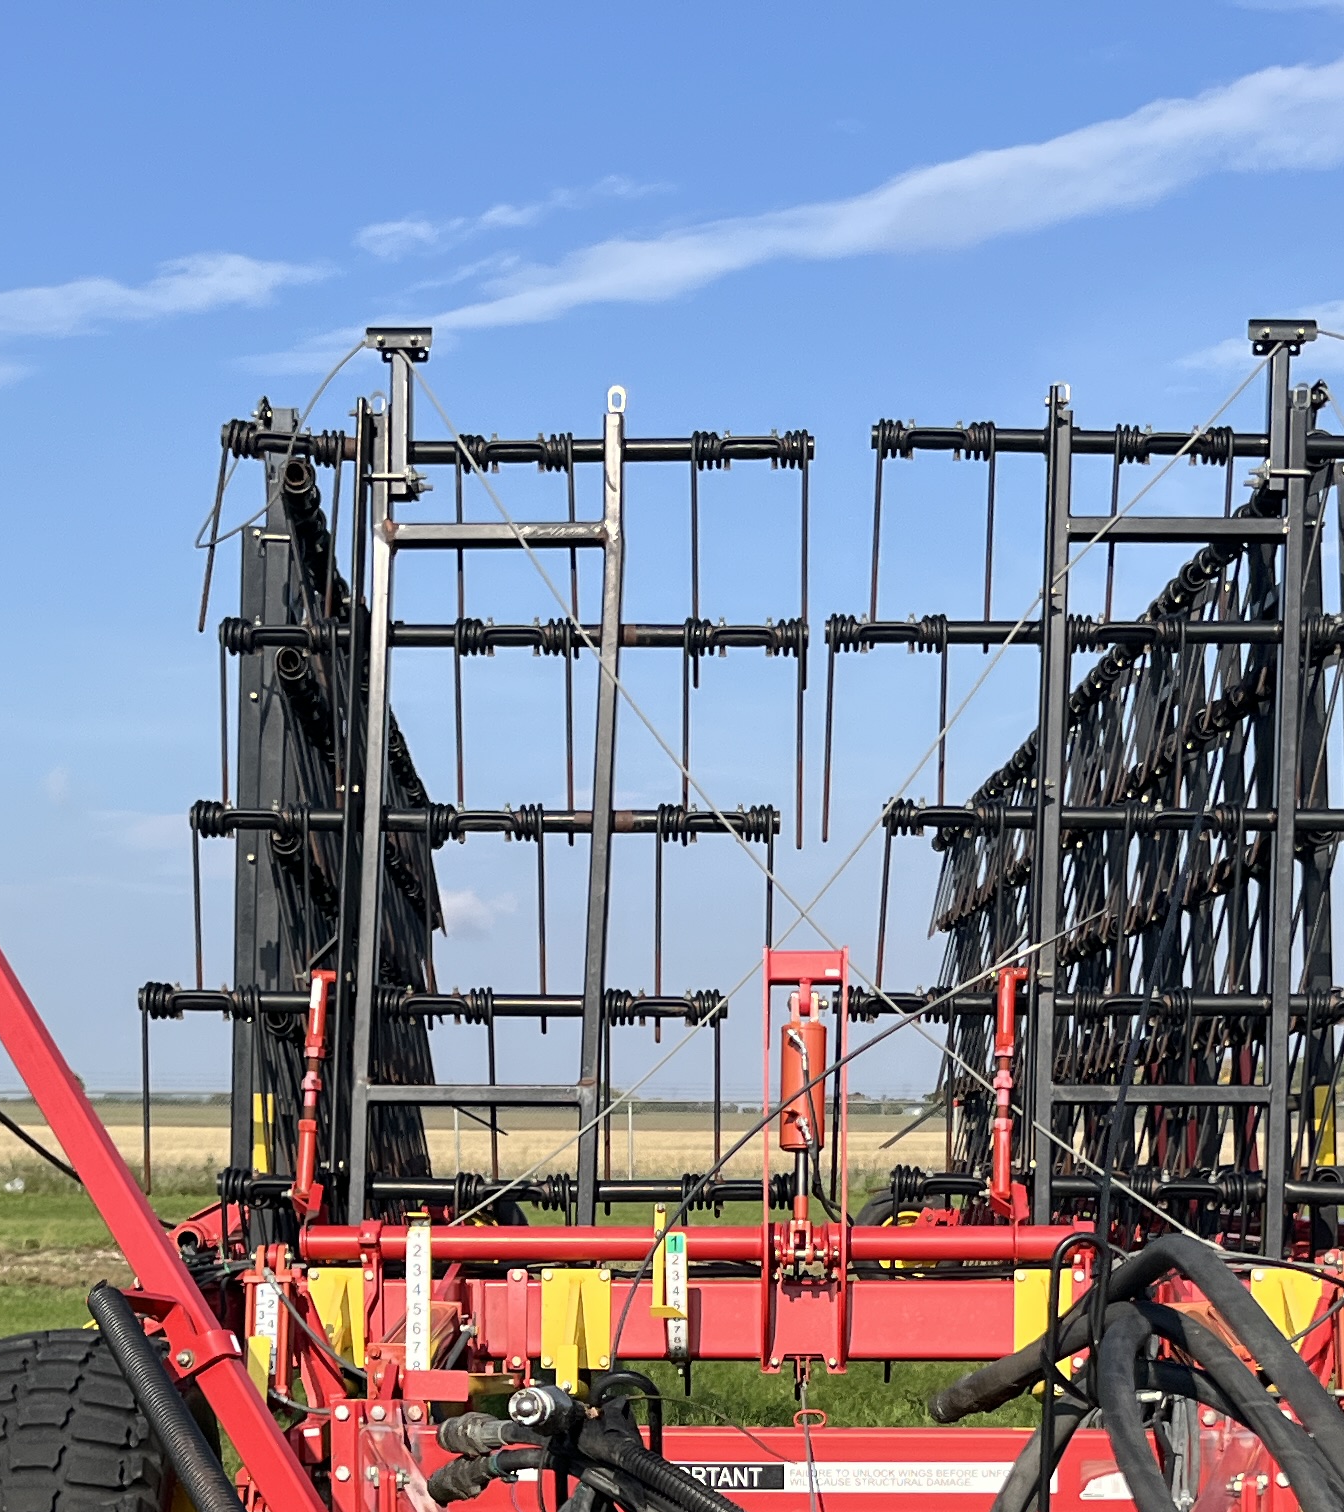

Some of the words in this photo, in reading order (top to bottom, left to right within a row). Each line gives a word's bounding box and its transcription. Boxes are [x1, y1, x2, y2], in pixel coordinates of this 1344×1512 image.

[671, 1235, 677, 1252] 1
[413, 1244, 422, 1257] 2
[671, 1254, 679, 1265] 2
[413, 1263, 422, 1277] 3
[672, 1270, 680, 1281] 3
[260, 1289, 265, 1297] 1
[412, 1283, 421, 1296] 4
[672, 1286, 680, 1296] 4
[267, 1299, 275, 1309] 2
[413, 1303, 422, 1315] 5
[258, 1310, 265, 1320] 3
[267, 1319, 275, 1329] 4
[412, 1322, 421, 1335] 6
[674, 1325, 681, 1334] 7
[413, 1341, 421, 1353] 7
[679, 1466, 763, 1488] RTANT
[789, 1469, 833, 1478] FAILRE
[835, 1469, 850, 1478] TO
[852, 1469, 896, 1478] UNLOCK
[898, 1469, 933, 1478] WINGS
[936, 1469, 978, 1478] BEFORE
[789, 1478, 808, 1487] WIL
[818, 1478, 852, 1487] CAUSE
[855, 1478, 923, 1487] STRUCTURAL
